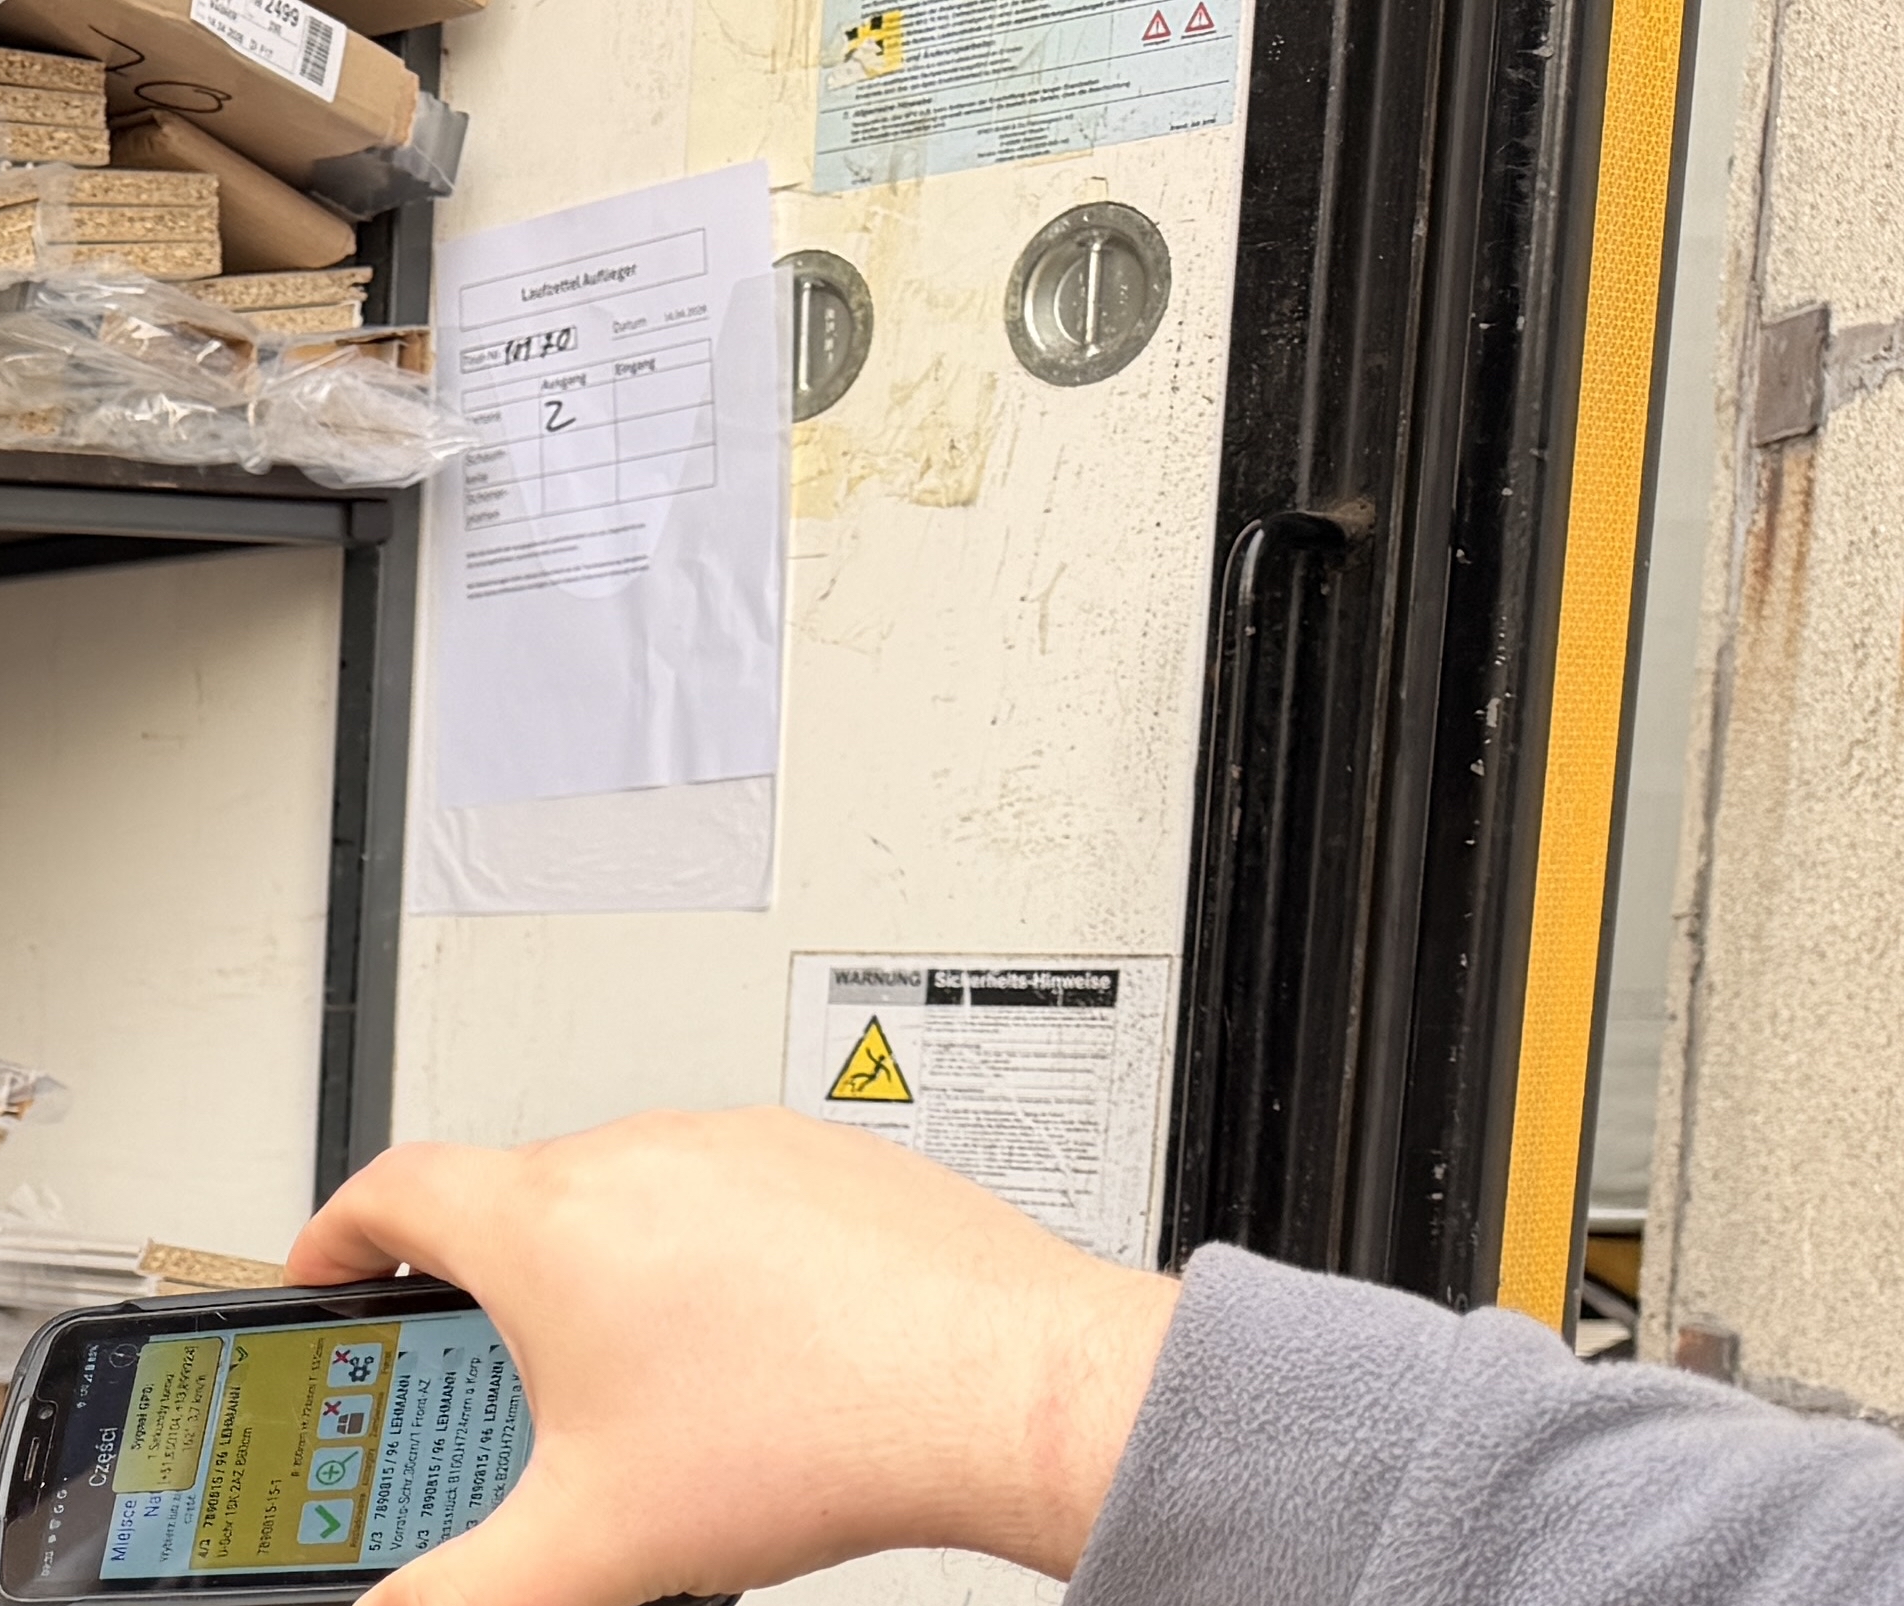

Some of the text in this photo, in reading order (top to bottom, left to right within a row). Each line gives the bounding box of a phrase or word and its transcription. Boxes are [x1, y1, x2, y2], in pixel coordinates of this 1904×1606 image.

[544, 400, 577, 433] 2
[388, 1373, 411, 1435] LEHMANN
[434, 1370, 457, 1432] LEHMANN
[482, 1359, 505, 1422] LEHMANN
[86, 1425, 122, 1487] Części
[384, 1440, 399, 1456] 96
[431, 1437, 445, 1454] 96
[479, 1427, 493, 1443] 96
[372, 1466, 395, 1520] 7890815
[420, 1463, 441, 1517] 7890815
[468, 1453, 490, 1508] 7890815
[109, 1499, 141, 1561] Miejsce
[368, 1530, 384, 1551] 5/3
[415, 1529, 430, 1550] 6/3
